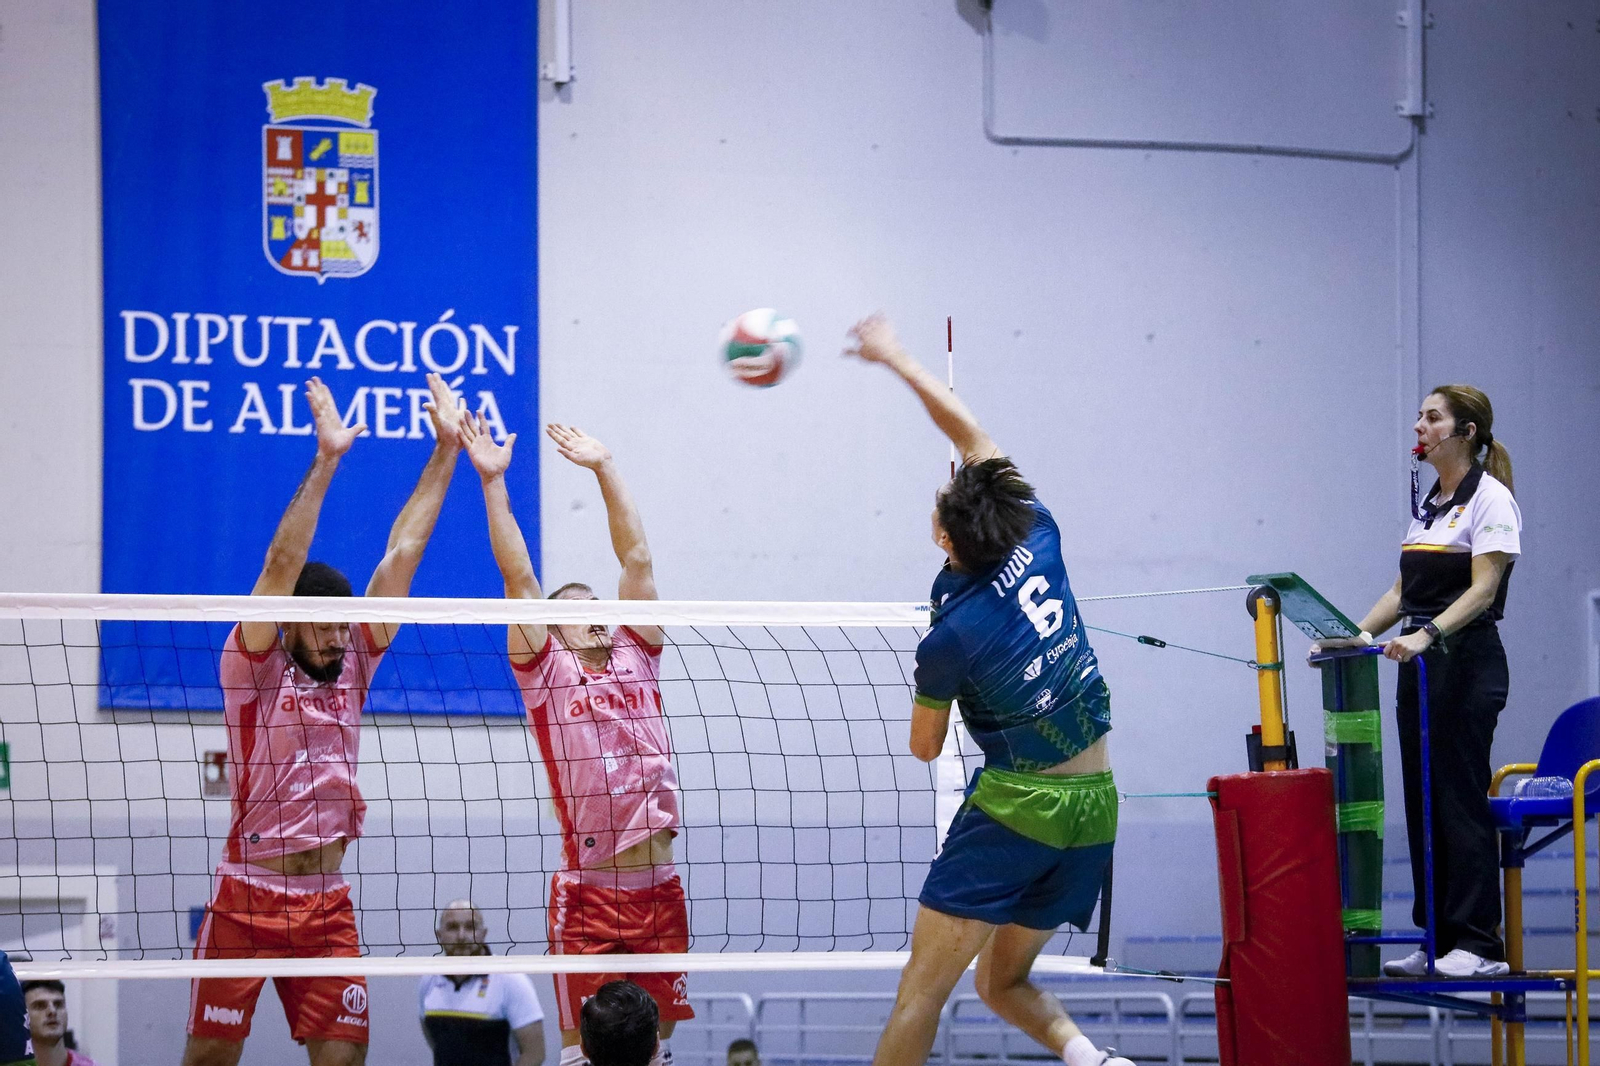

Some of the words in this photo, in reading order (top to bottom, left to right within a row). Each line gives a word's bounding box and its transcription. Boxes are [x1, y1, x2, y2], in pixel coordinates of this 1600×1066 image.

[120, 308, 519, 376] DIPUTACIÓN
[129, 378, 213, 432] DE
[1018, 575, 1064, 641] 6
